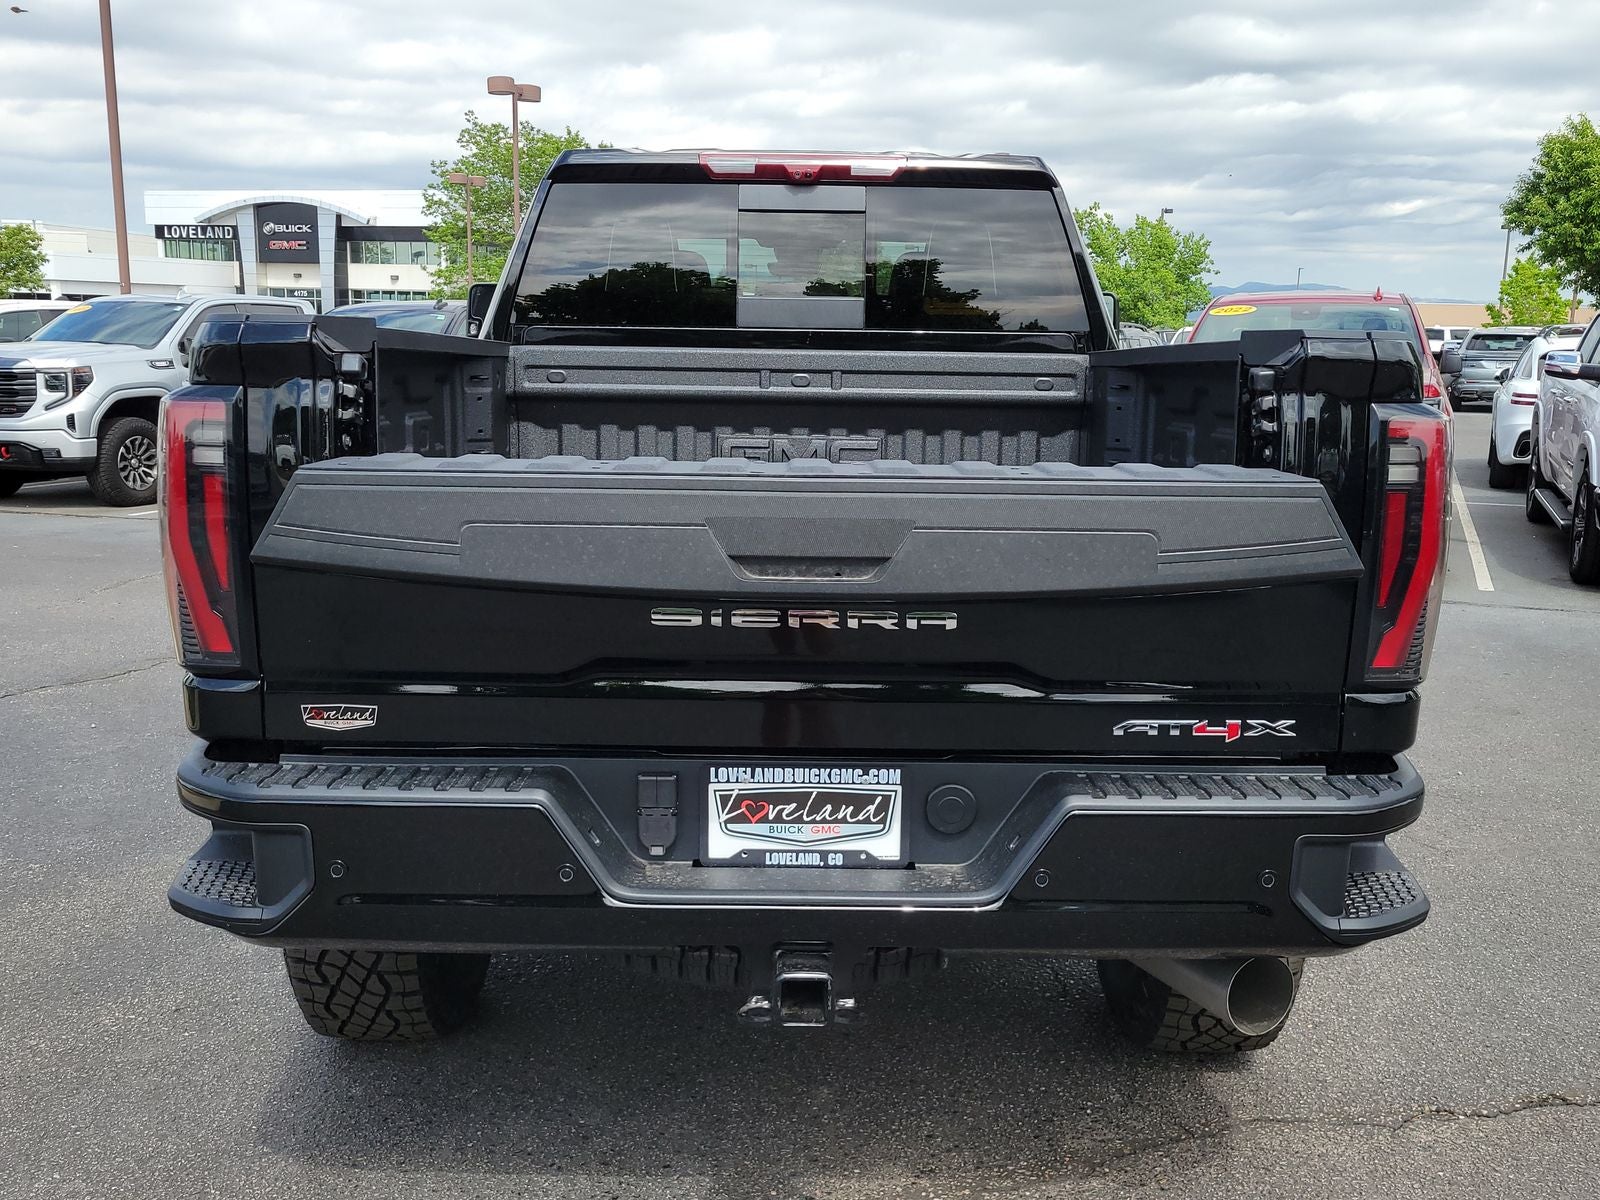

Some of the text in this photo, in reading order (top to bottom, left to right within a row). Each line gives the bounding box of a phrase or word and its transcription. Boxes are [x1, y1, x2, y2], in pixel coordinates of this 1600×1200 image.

[164, 225, 233, 239] LOVELAND
[274, 224, 313, 233] BUICK
[268, 240, 308, 250] GMC
[721, 438, 878, 463] GMC
[651, 607, 957, 630] SIERRA
[1113, 719, 1297, 743] AT4X
[709, 767, 901, 784] LOVELANDBUICKGMCCOM
[768, 825, 841, 834] BUICK GMC
[765, 852, 844, 867] LOVELAND, CO
